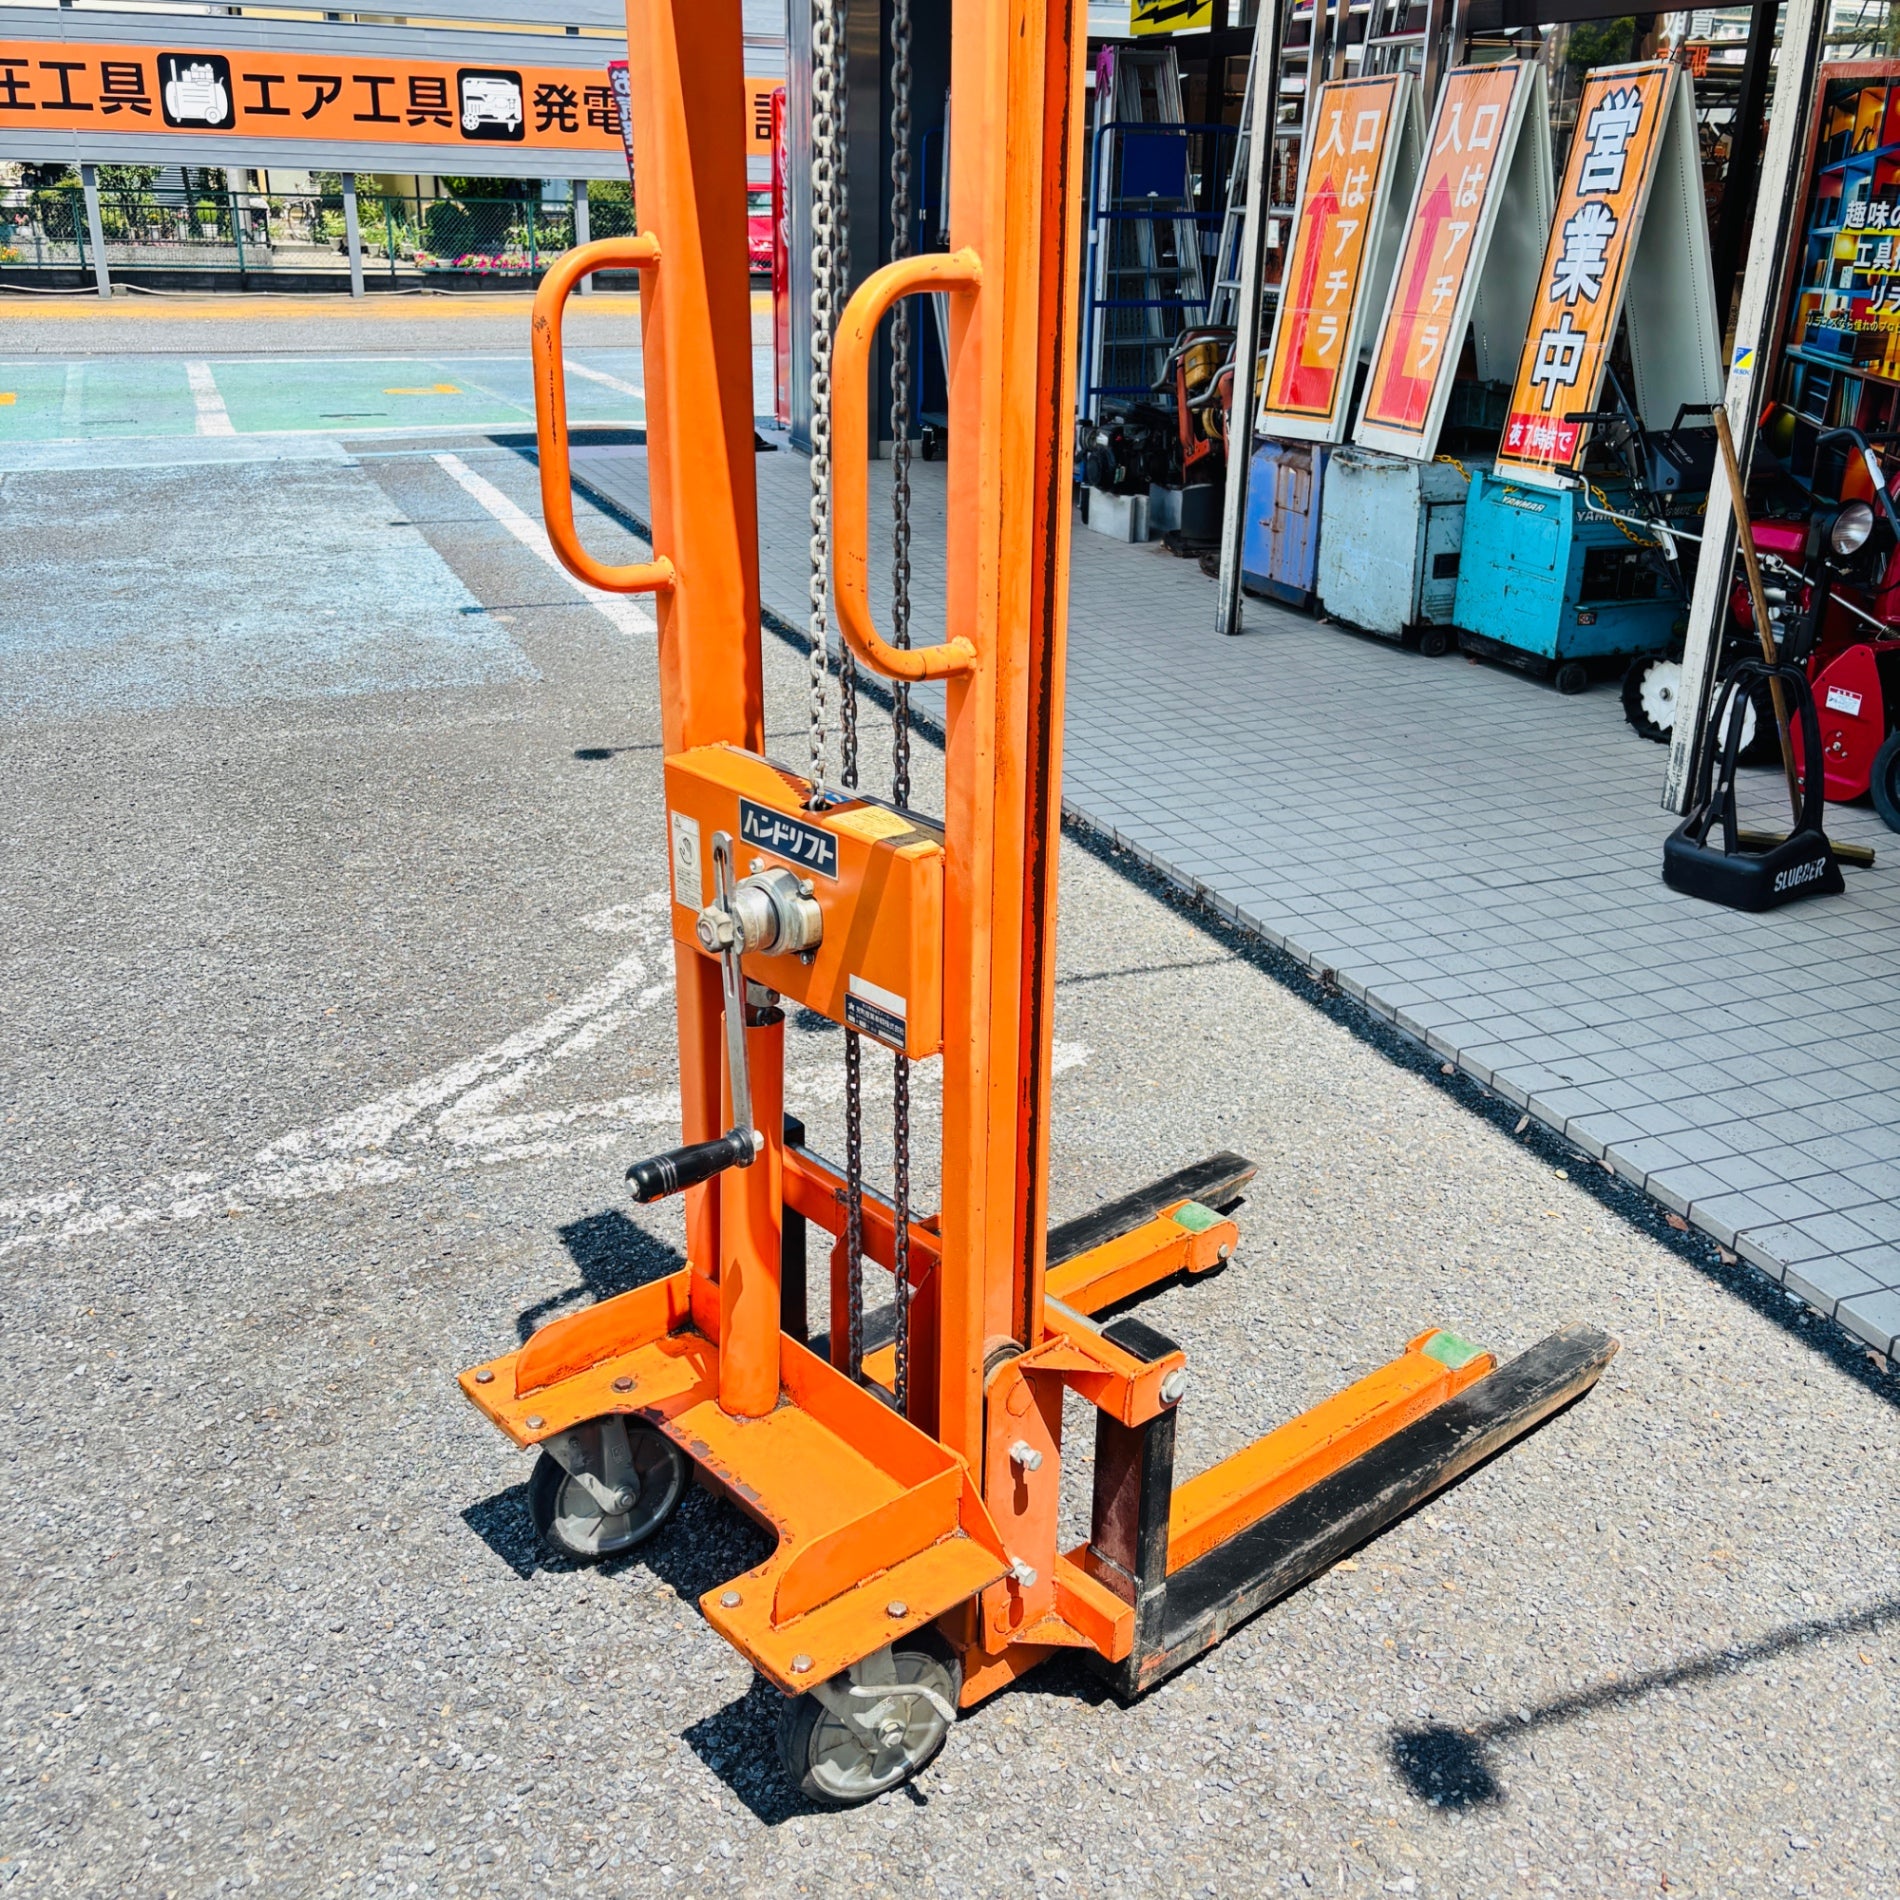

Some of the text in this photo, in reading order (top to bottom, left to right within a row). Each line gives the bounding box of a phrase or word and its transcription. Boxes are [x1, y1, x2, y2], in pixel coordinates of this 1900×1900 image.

[242, 73, 453, 129] エア工具
[1317, 109, 1382, 160] 入口
[1436, 102, 1501, 157] 入口
[1317, 165, 1370, 356] はアチラ
[1418, 163, 1485, 369] はアチラ
[1530, 84, 1642, 412] 営業中
[1508, 421, 1574, 453] 夜7時まで
[1501, 495, 1546, 513] YANMAR
[743, 809, 834, 865] ハンドリフト
